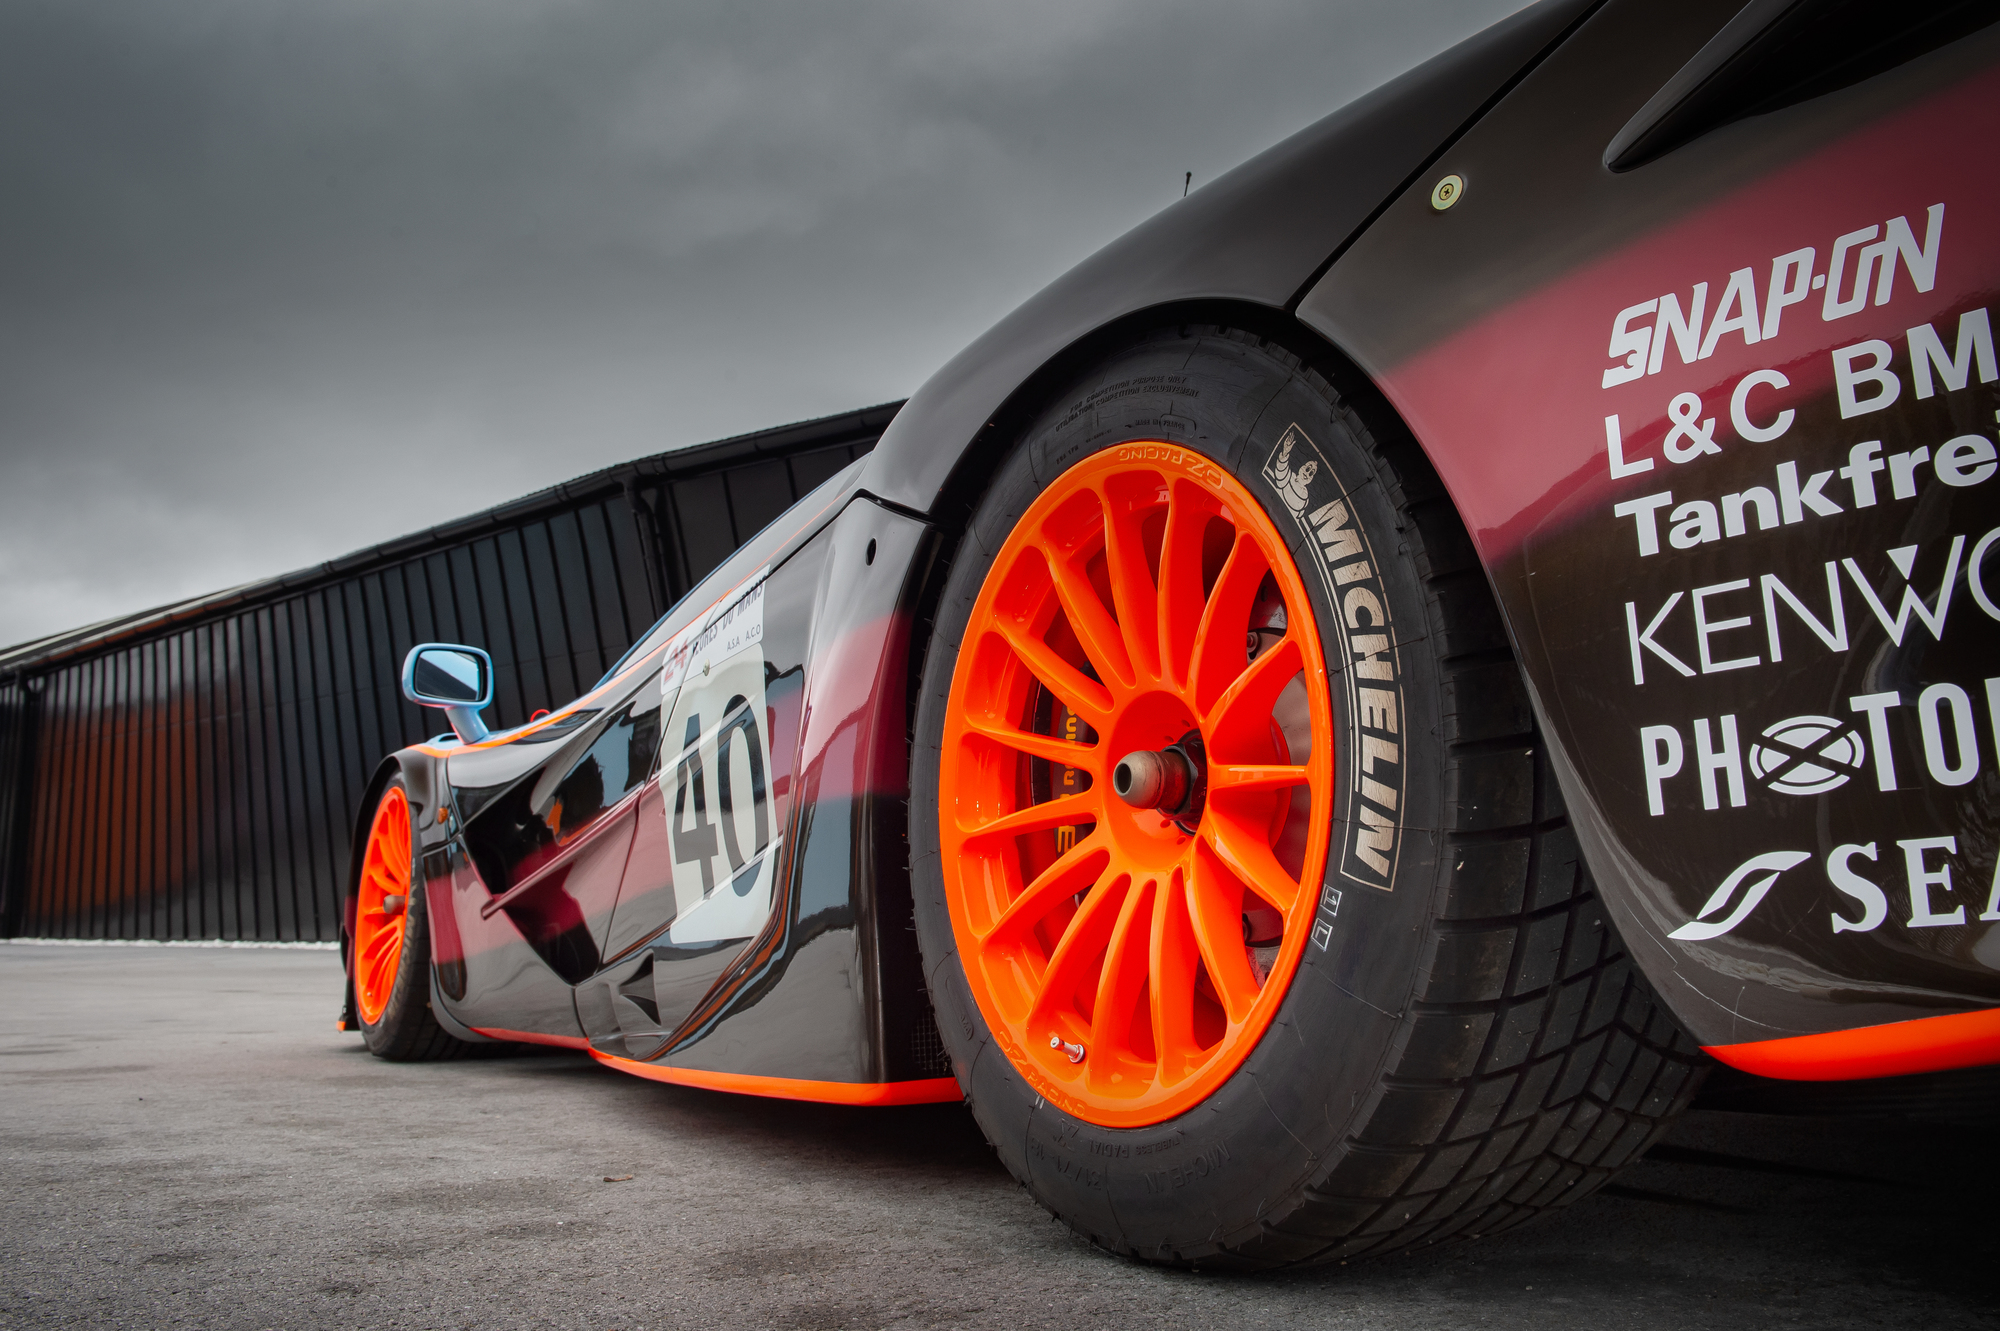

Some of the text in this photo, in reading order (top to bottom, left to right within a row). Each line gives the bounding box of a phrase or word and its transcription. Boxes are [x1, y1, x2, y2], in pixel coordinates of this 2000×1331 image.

[1055, 385, 1200, 432] UTILISATION COMPETITION EXCLUSIVEMENT
[1086, 380, 1130, 403] COMPETITION
[1132, 375, 1164, 386] PURPOSE
[1167, 375, 1187, 384] ONLY
[1118, 447, 1223, 490] OZ RACING
[1614, 409, 2000, 557] Tankfre
[1307, 498, 1399, 878] MICHELIN
[672, 694, 770, 901] 40
[1826, 836, 2000, 934] SE
[1026, 1070, 1086, 1116] RACING
[1089, 1136, 1181, 1159] TUBELESS RADIAL
[1142, 1140, 1231, 1194] MICHELIN
